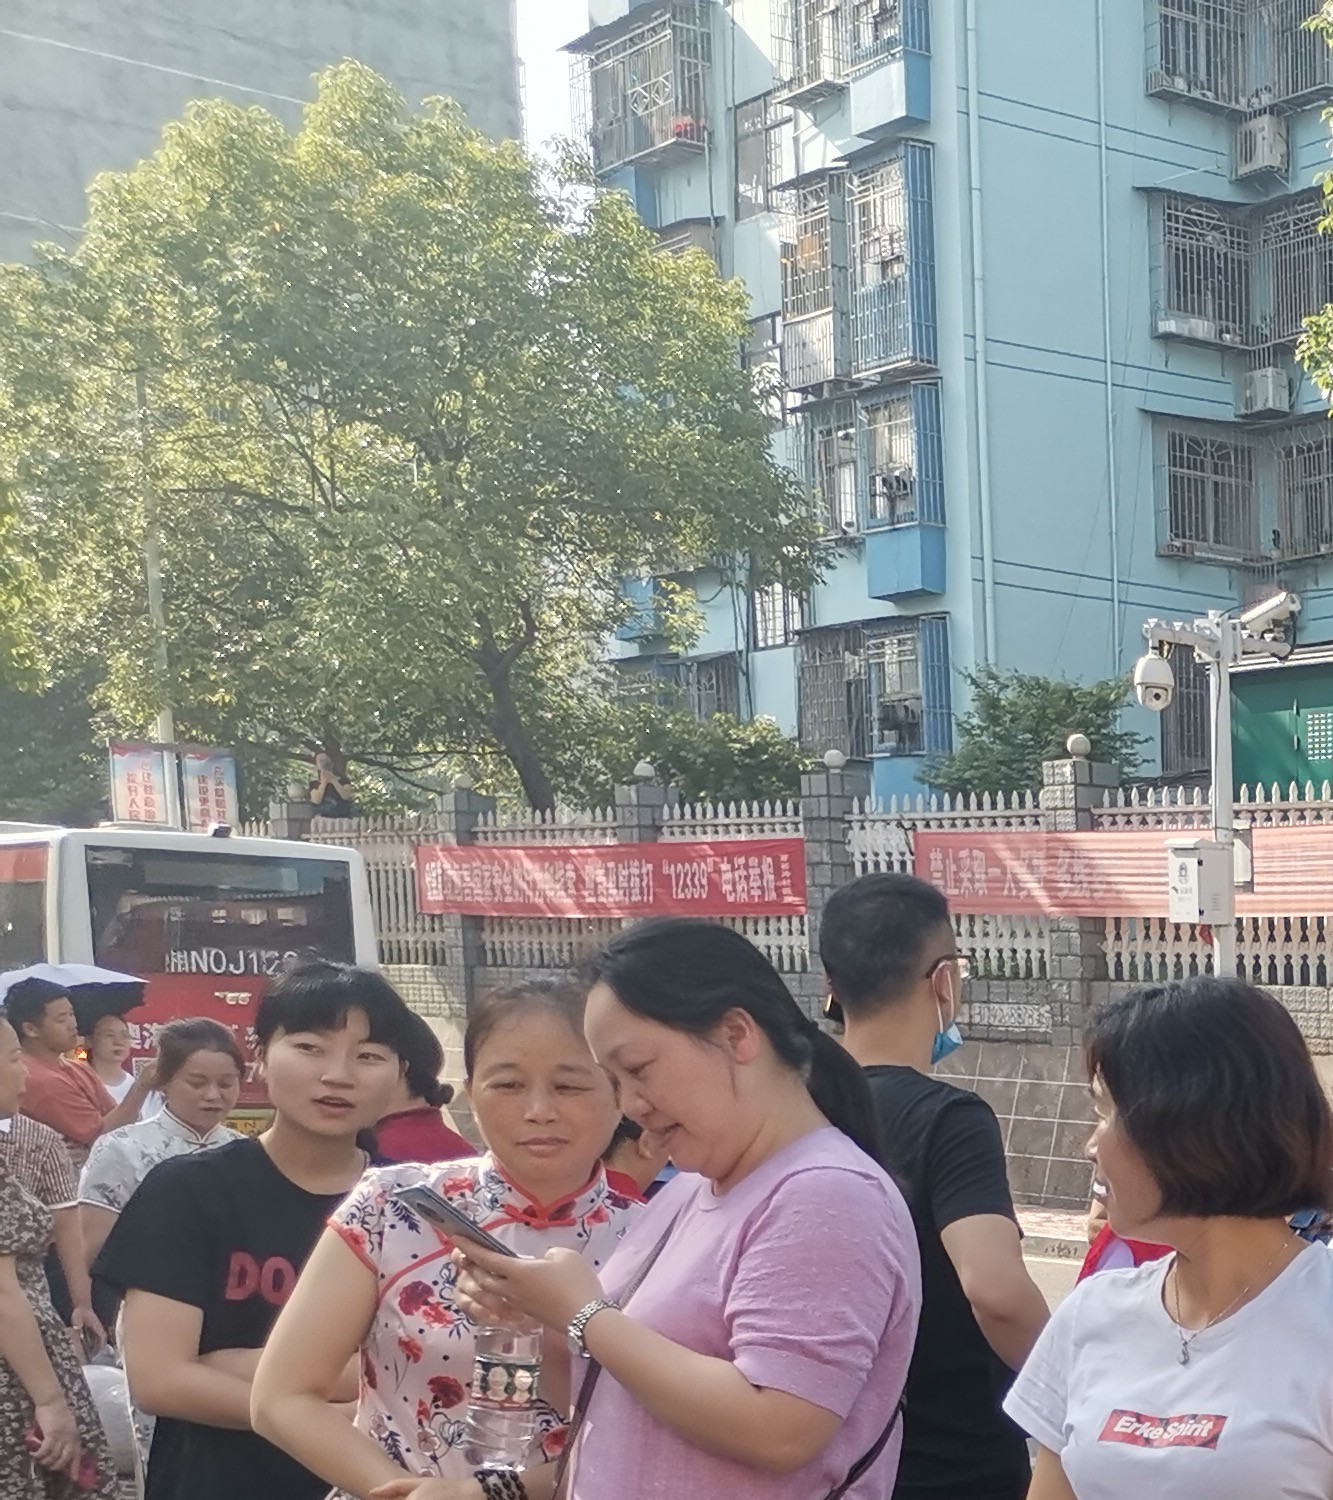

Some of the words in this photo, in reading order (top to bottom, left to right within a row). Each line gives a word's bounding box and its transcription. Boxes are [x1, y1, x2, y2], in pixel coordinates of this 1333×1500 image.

[720, 855, 777, 903] 电话举报
[1113, 1415, 1164, 1440] Erke
[1163, 1419, 1214, 1442] Spirit
